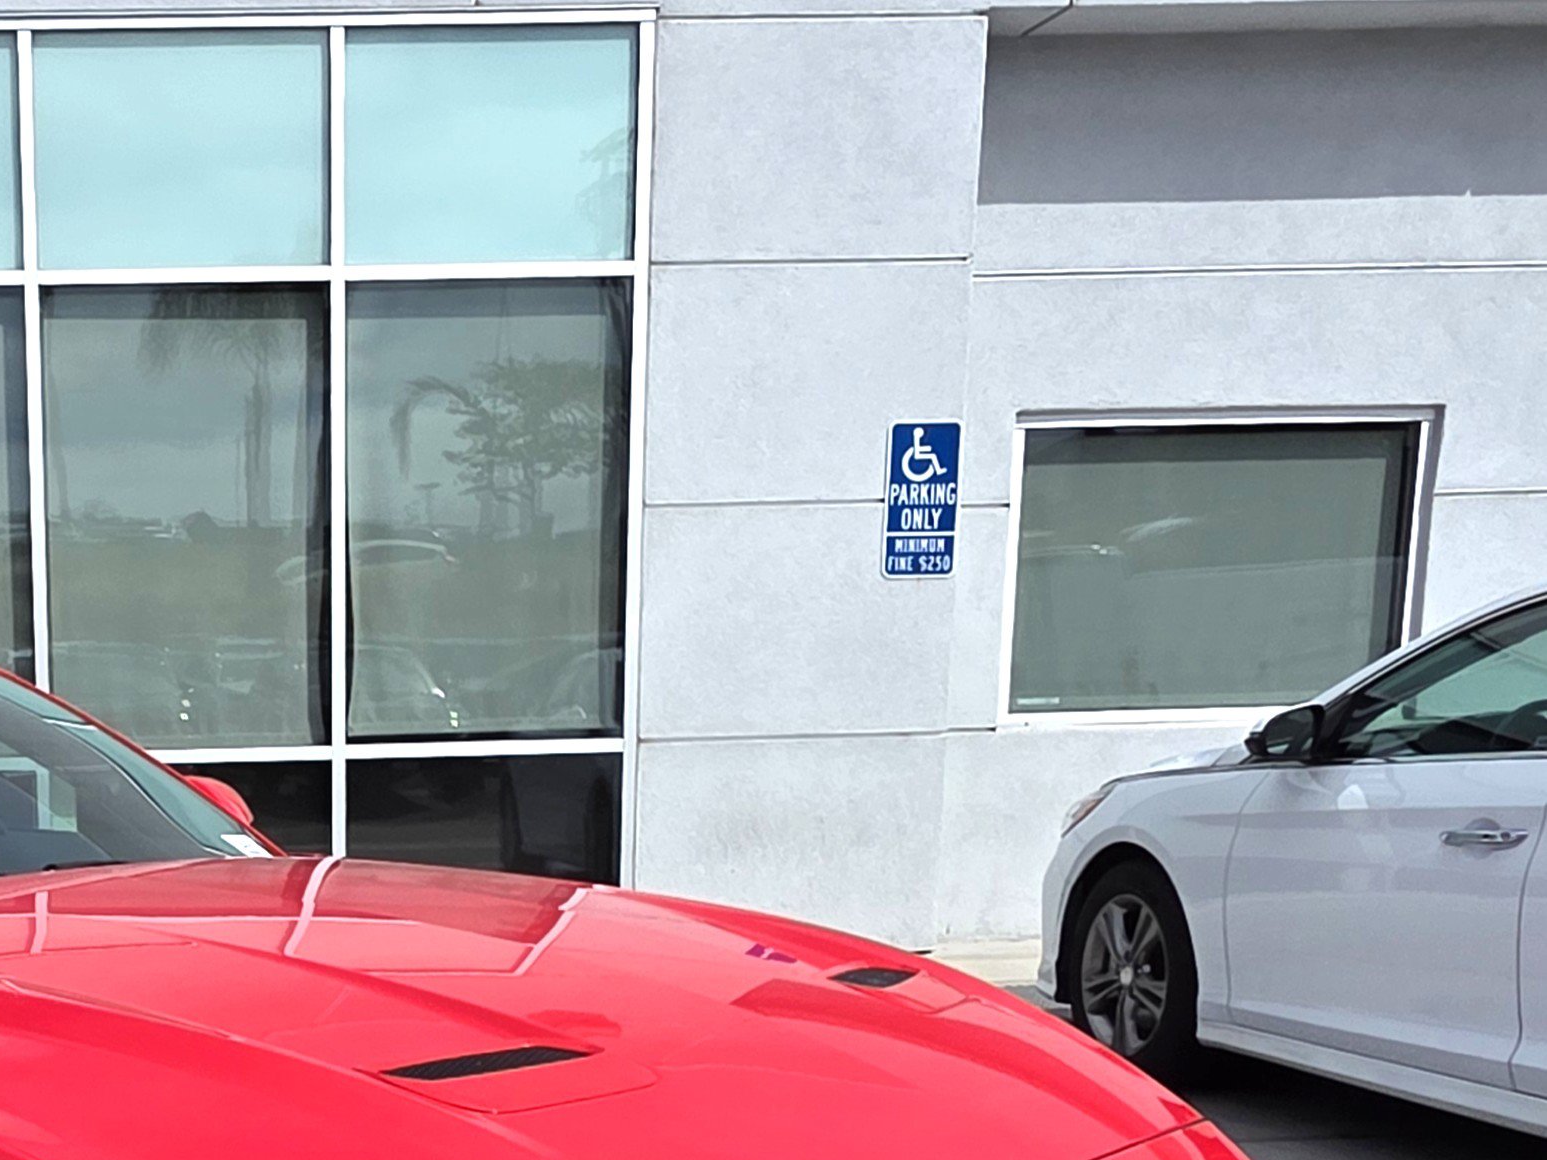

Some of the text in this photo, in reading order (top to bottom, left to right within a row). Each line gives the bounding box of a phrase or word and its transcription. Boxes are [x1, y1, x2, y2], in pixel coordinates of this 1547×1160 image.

[889, 482, 957, 506] PARKING
[900, 507, 943, 530] ONLY
[894, 538, 946, 553] MINIMUM
[887, 555, 951, 572] FINE $250
